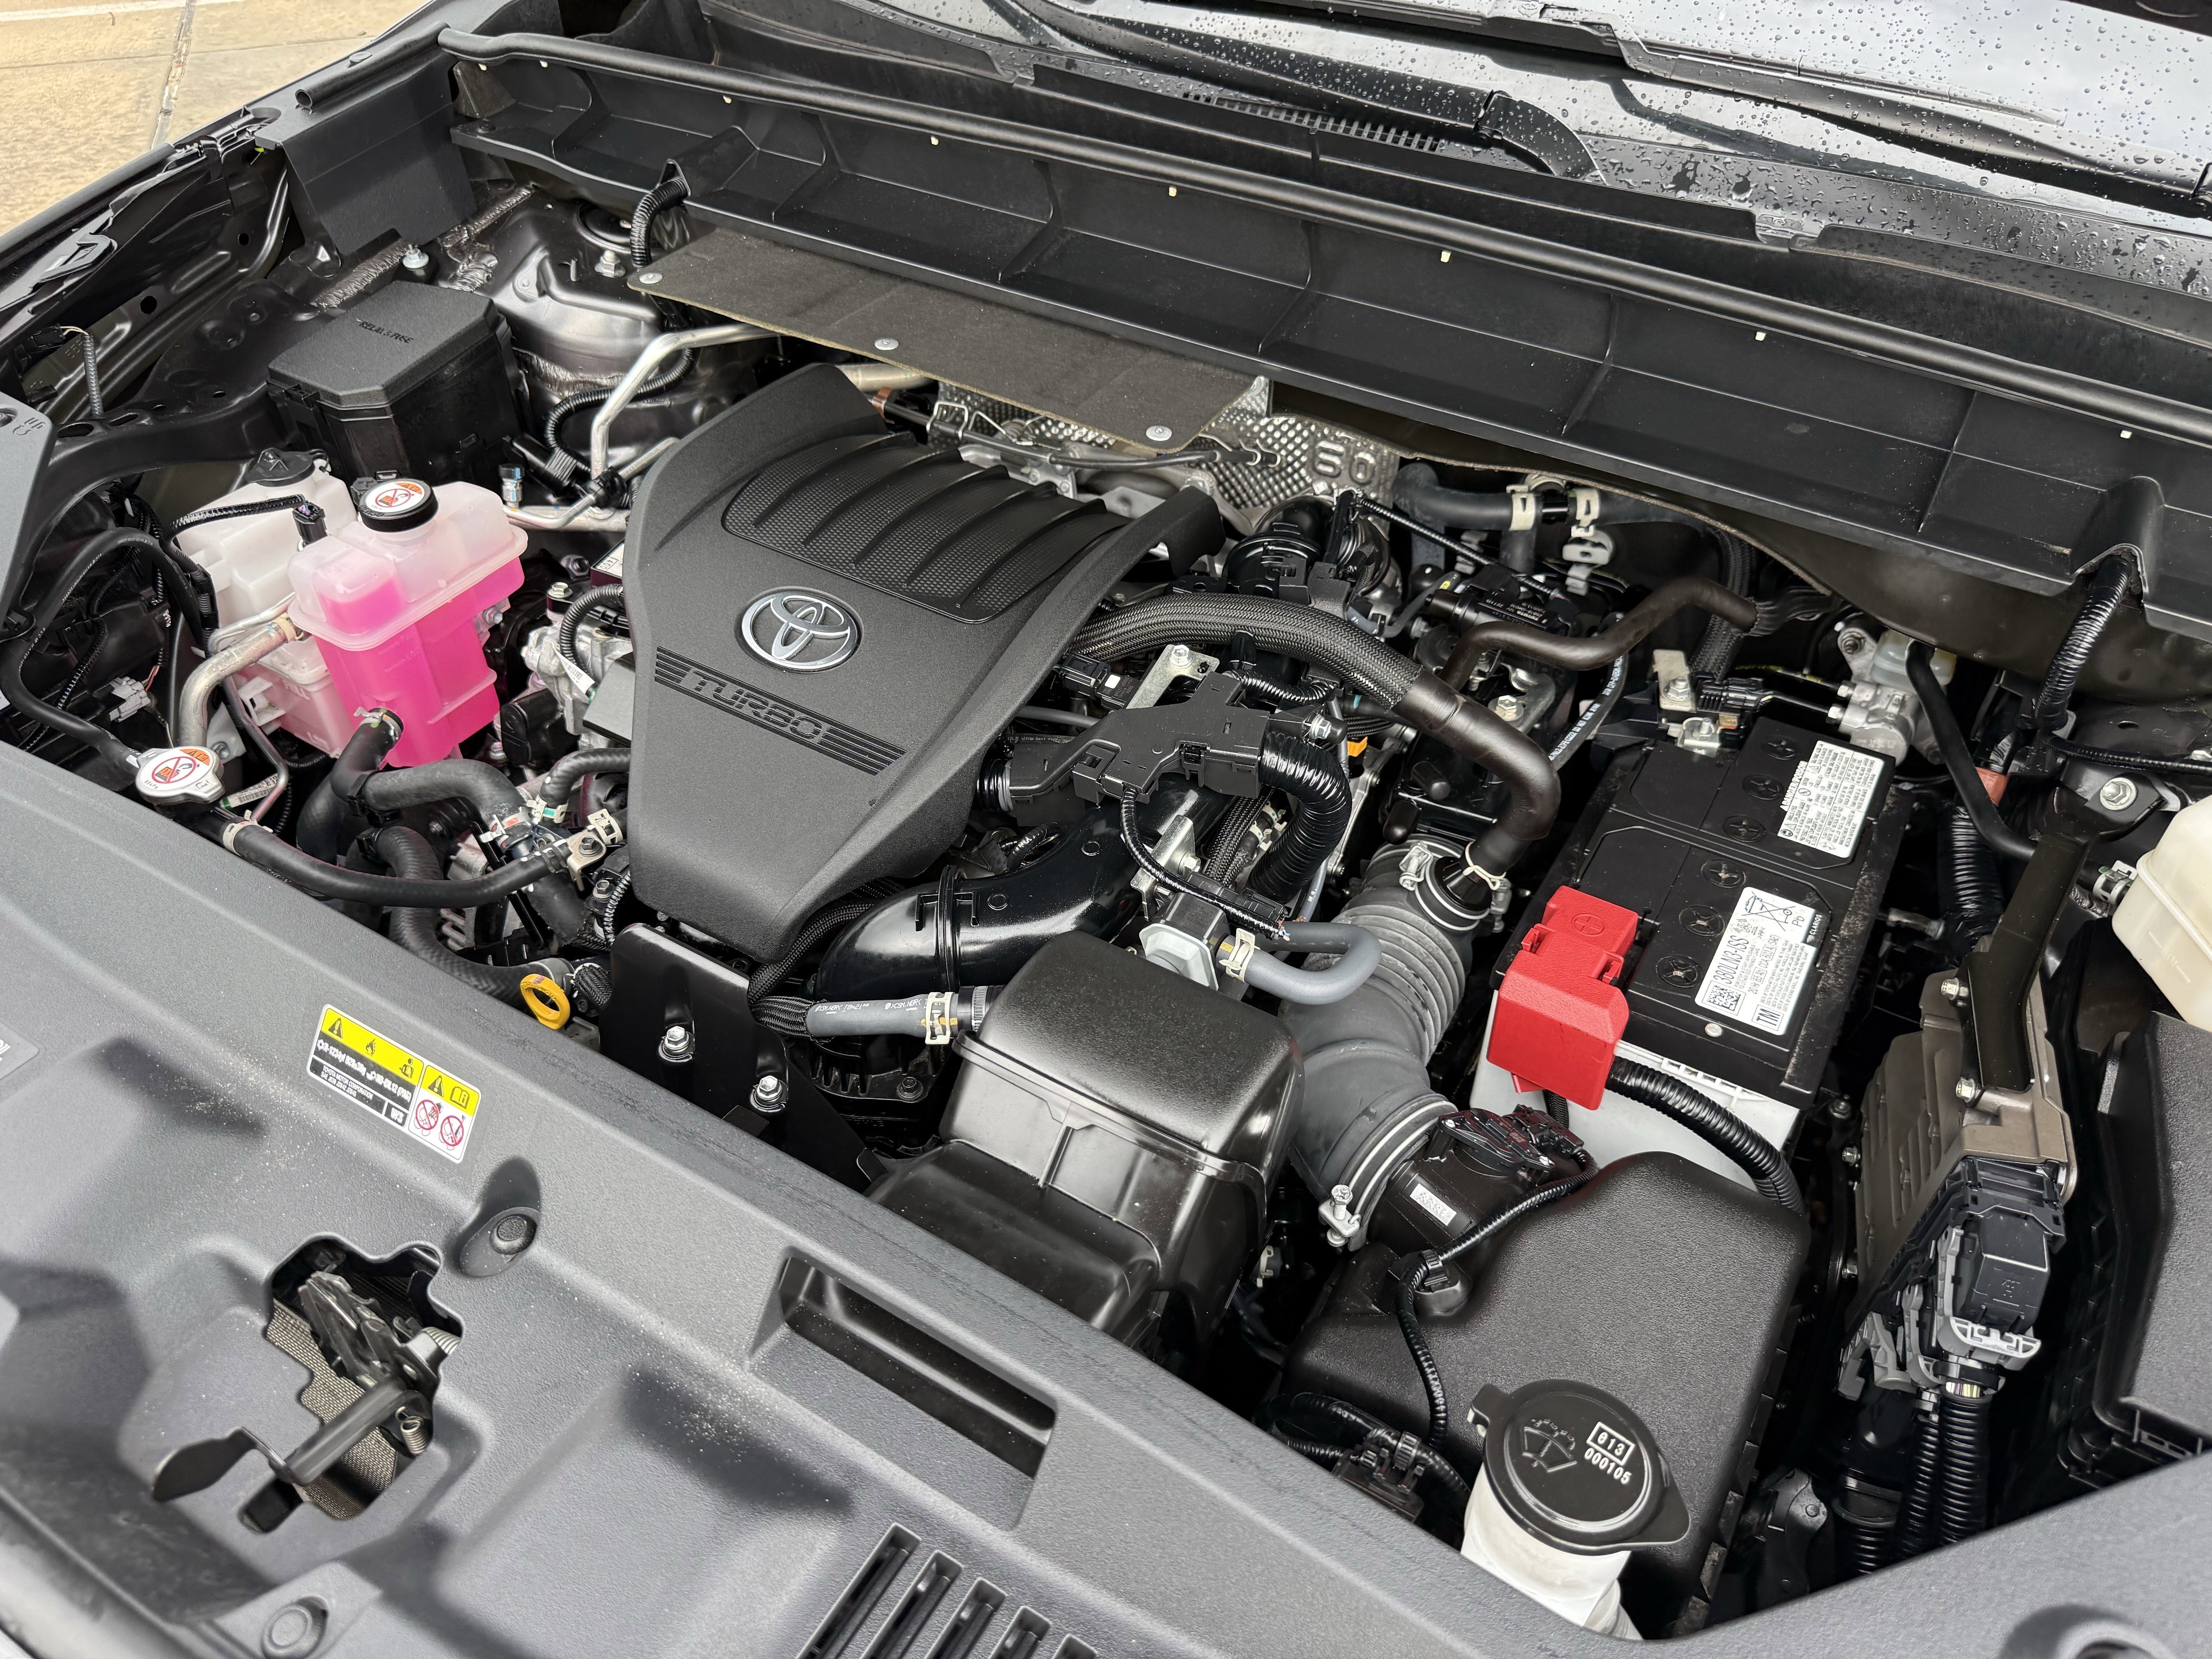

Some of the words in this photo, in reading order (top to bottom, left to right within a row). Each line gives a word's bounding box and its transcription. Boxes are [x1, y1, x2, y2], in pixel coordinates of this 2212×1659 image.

[686, 670, 824, 742] TURBO
[1781, 760, 1807, 807] DANGER/POISON
[1791, 915, 1805, 927] Pb
[1809, 914, 1822, 935] CLARIOS
[1766, 933, 1782, 947] (SAE)
[1712, 934, 1750, 984] 380LN3-ISS
[1744, 944, 1755, 962] APPLICABLE
[1758, 958, 1770, 968] CCA
[1762, 949, 1773, 959] 603
[1756, 1008, 1781, 1027] TM
[320, 1070, 329, 1079] SAE
[321, 1065, 337, 1078] TOYOTA
[335, 1073, 349, 1085] MOTOR
[347, 1080, 374, 1100] CORPORATION
[1595, 1431, 1626, 1457] e13
[1583, 1446, 1632, 1486] 000105
